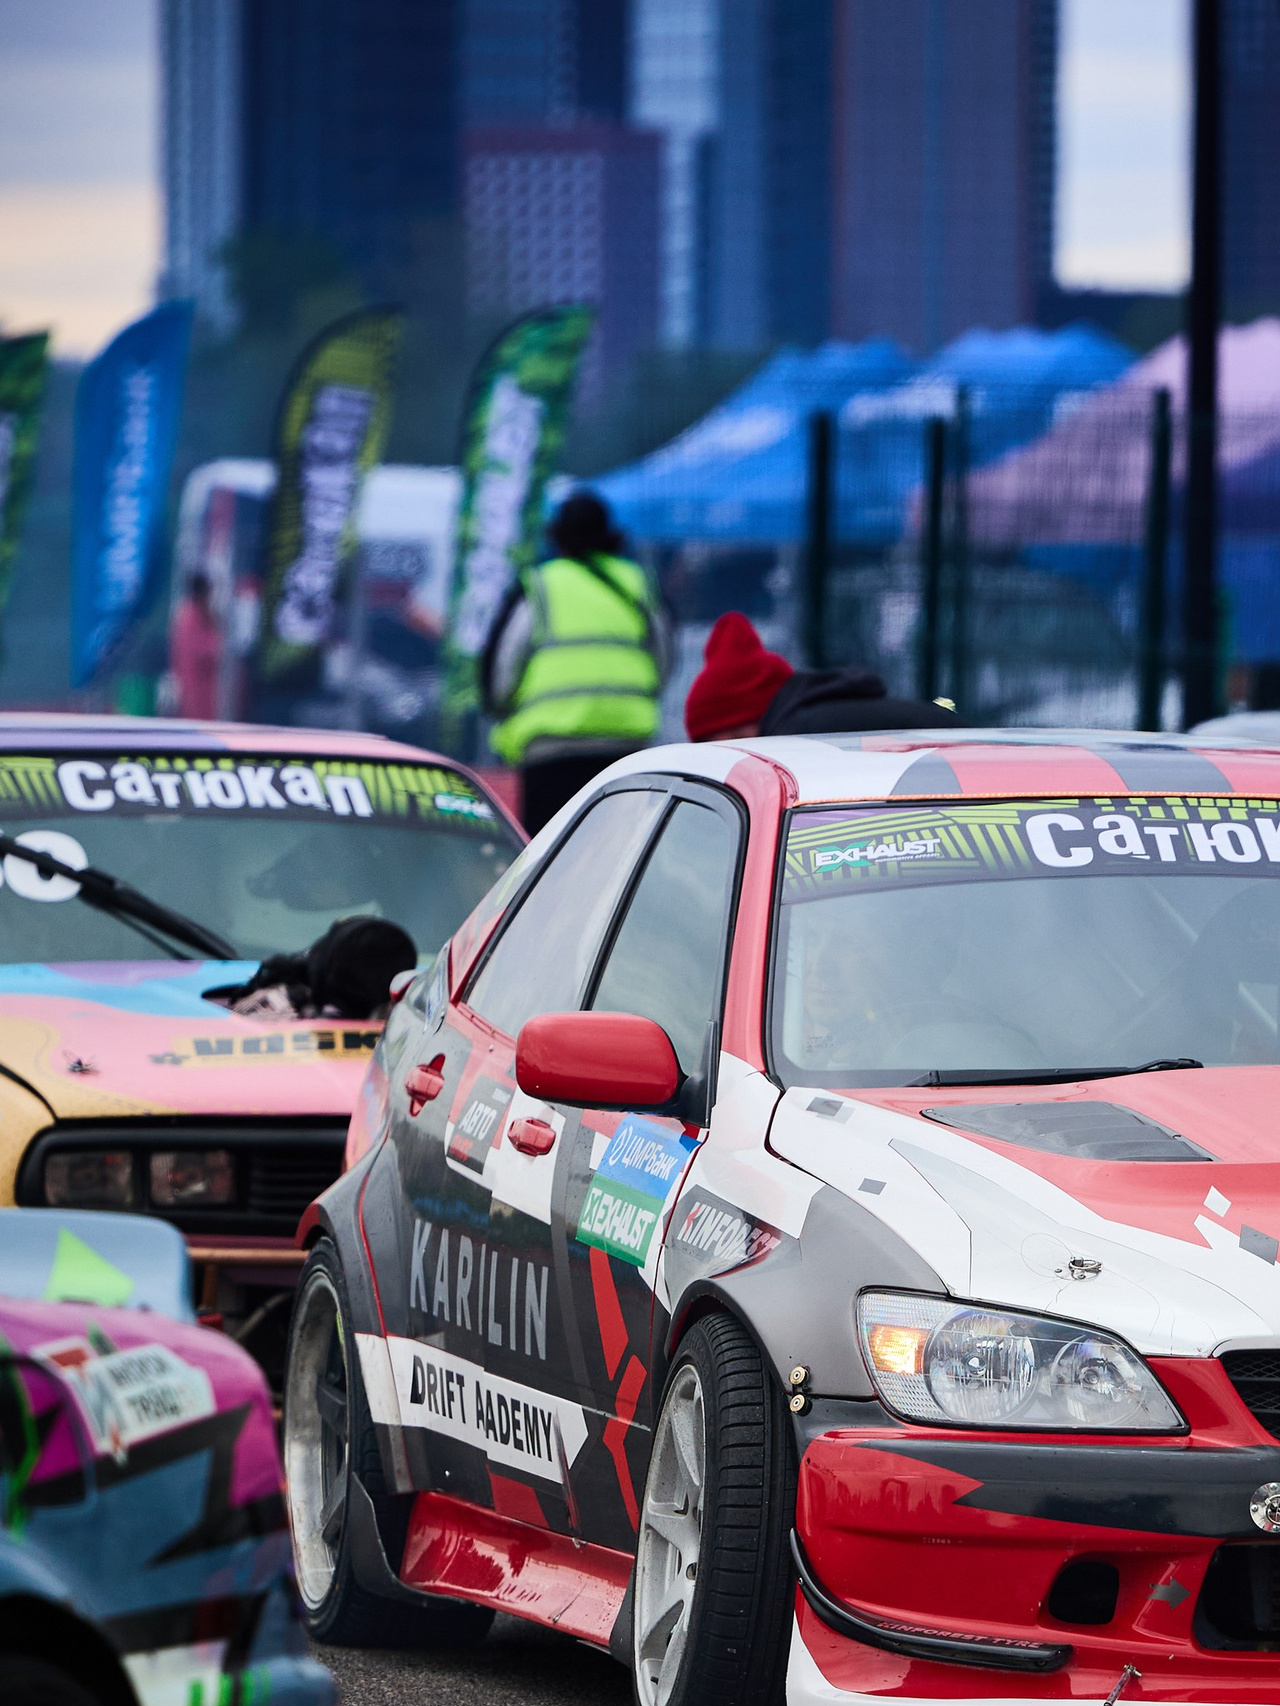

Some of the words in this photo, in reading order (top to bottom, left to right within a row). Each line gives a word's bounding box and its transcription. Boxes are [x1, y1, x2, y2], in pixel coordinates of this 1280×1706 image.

[815, 838, 941, 867] EXHAUST
[621, 1134, 680, 1182] ЦМРБанк
[592, 1193, 657, 1251] EXHAUST
[410, 1217, 549, 1361] KARILIN
[409, 1354, 467, 1425] DRIFT
[876, 1620, 989, 1642] KINFOREST
[992, 1637, 1044, 1649] TYRE
